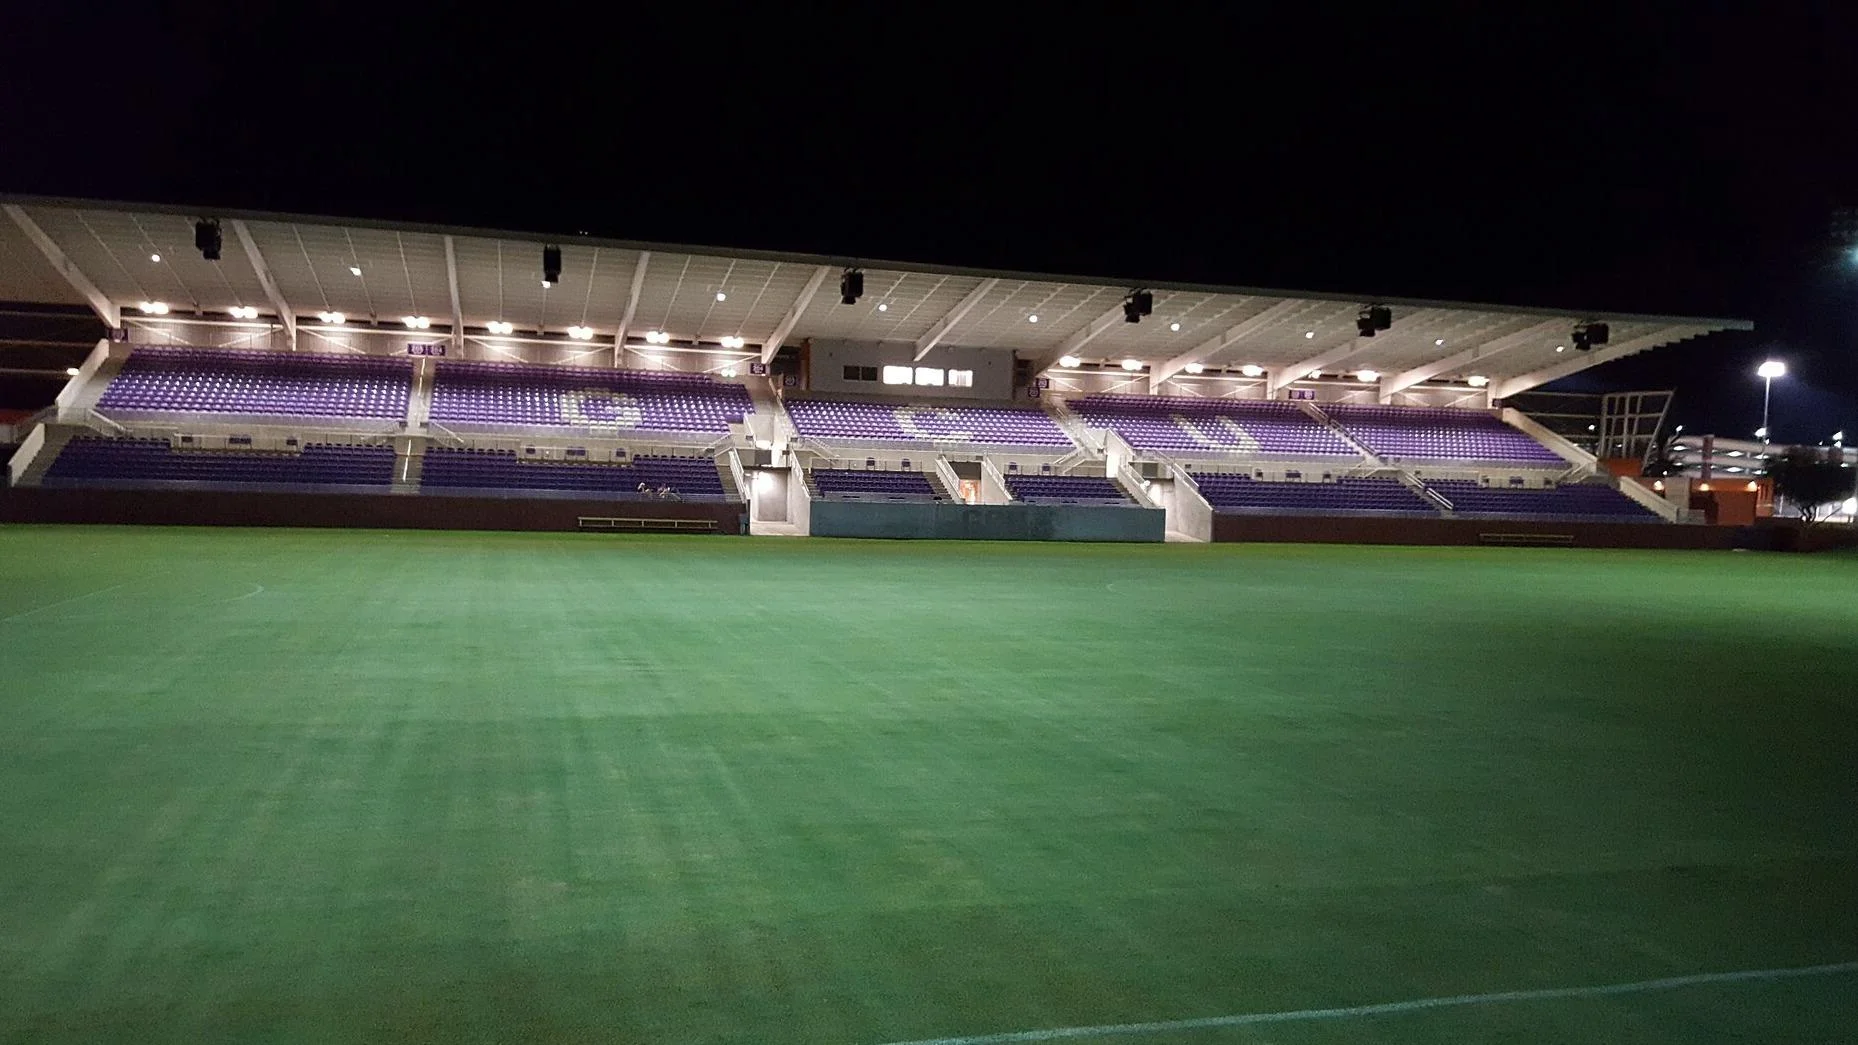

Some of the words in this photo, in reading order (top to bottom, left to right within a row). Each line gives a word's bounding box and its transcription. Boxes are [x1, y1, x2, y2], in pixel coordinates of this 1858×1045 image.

[559, 388, 642, 436] G
[892, 404, 972, 446] C
[1168, 414, 1260, 455] U
